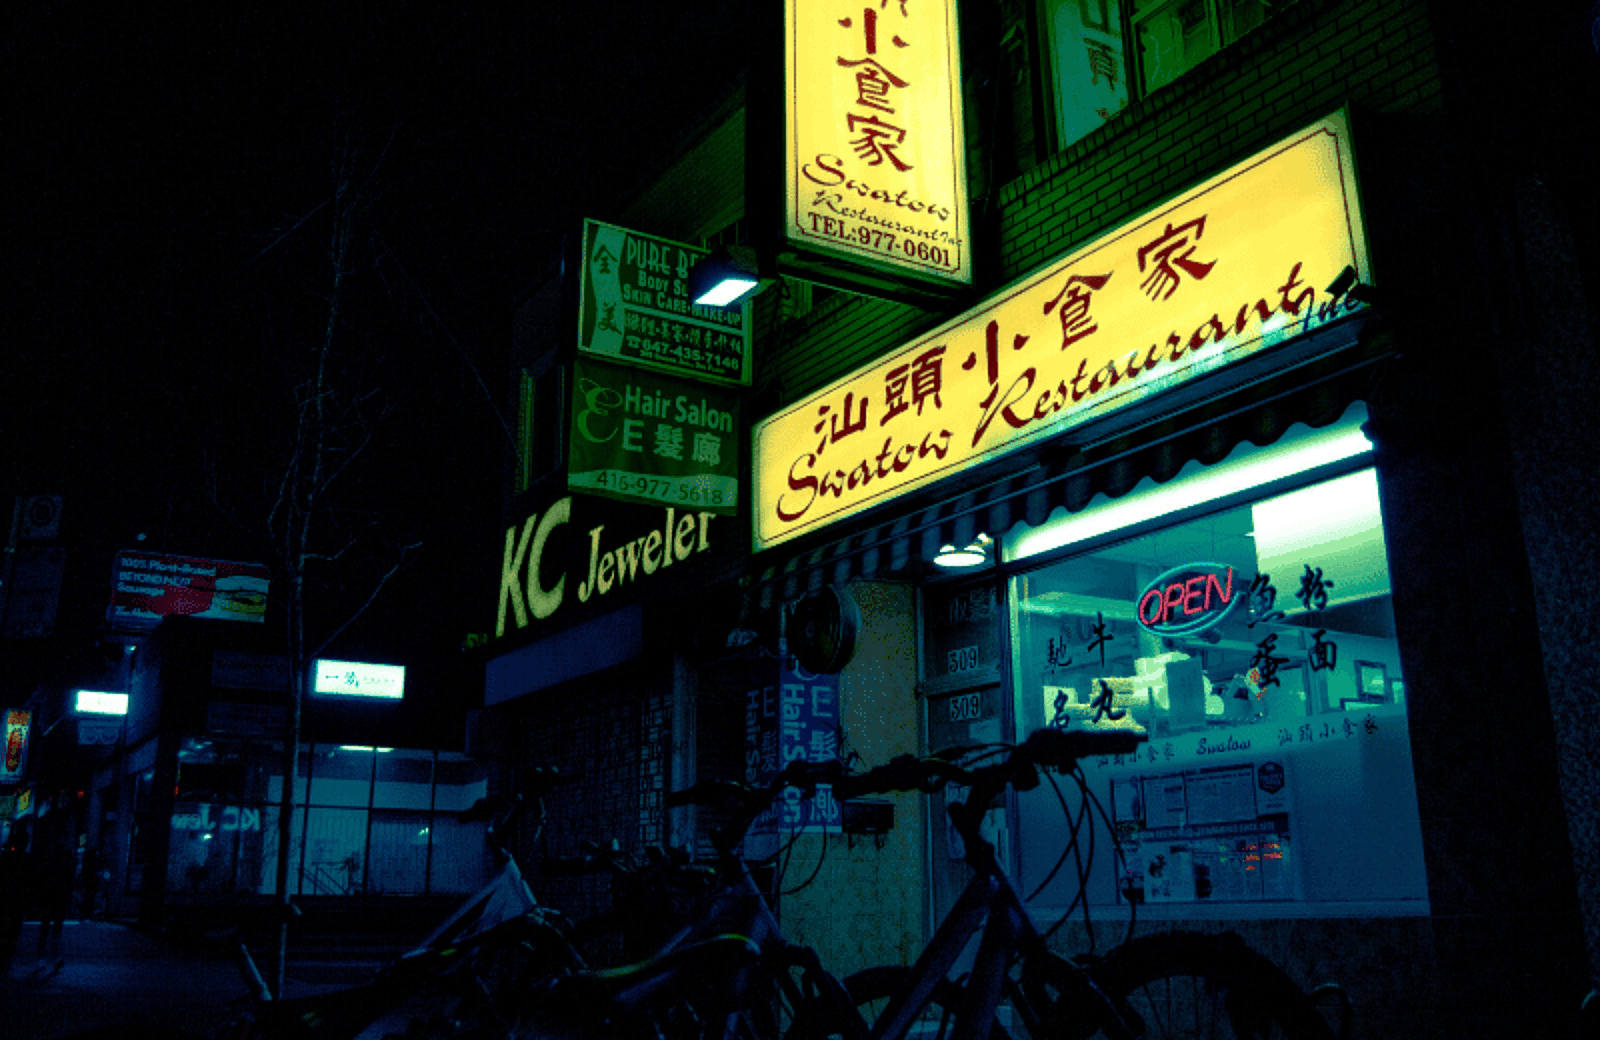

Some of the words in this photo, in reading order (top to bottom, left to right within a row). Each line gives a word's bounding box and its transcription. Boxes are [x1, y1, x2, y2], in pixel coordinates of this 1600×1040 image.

[837, 0, 914, 172] 小食家
[802, 153, 950, 222] Swatow
[812, 189, 941, 242] Restaurant
[626, 235, 671, 276] PURE
[808, 211, 950, 267] TEL:977-0601
[814, 214, 1217, 454] 汕頭小食家
[625, 384, 671, 418] Hair
[675, 395, 733, 433] Salon
[776, 425, 954, 521] Swatow
[971, 262, 1304, 448] Restaurant
[495, 496, 572, 638] KC
[577, 507, 717, 603] Jeweler
[1139, 567, 1234, 626] OPEN
[949, 647, 977, 673] 309
[783, 683, 806, 741] Hair
[951, 695, 979, 720] 309
